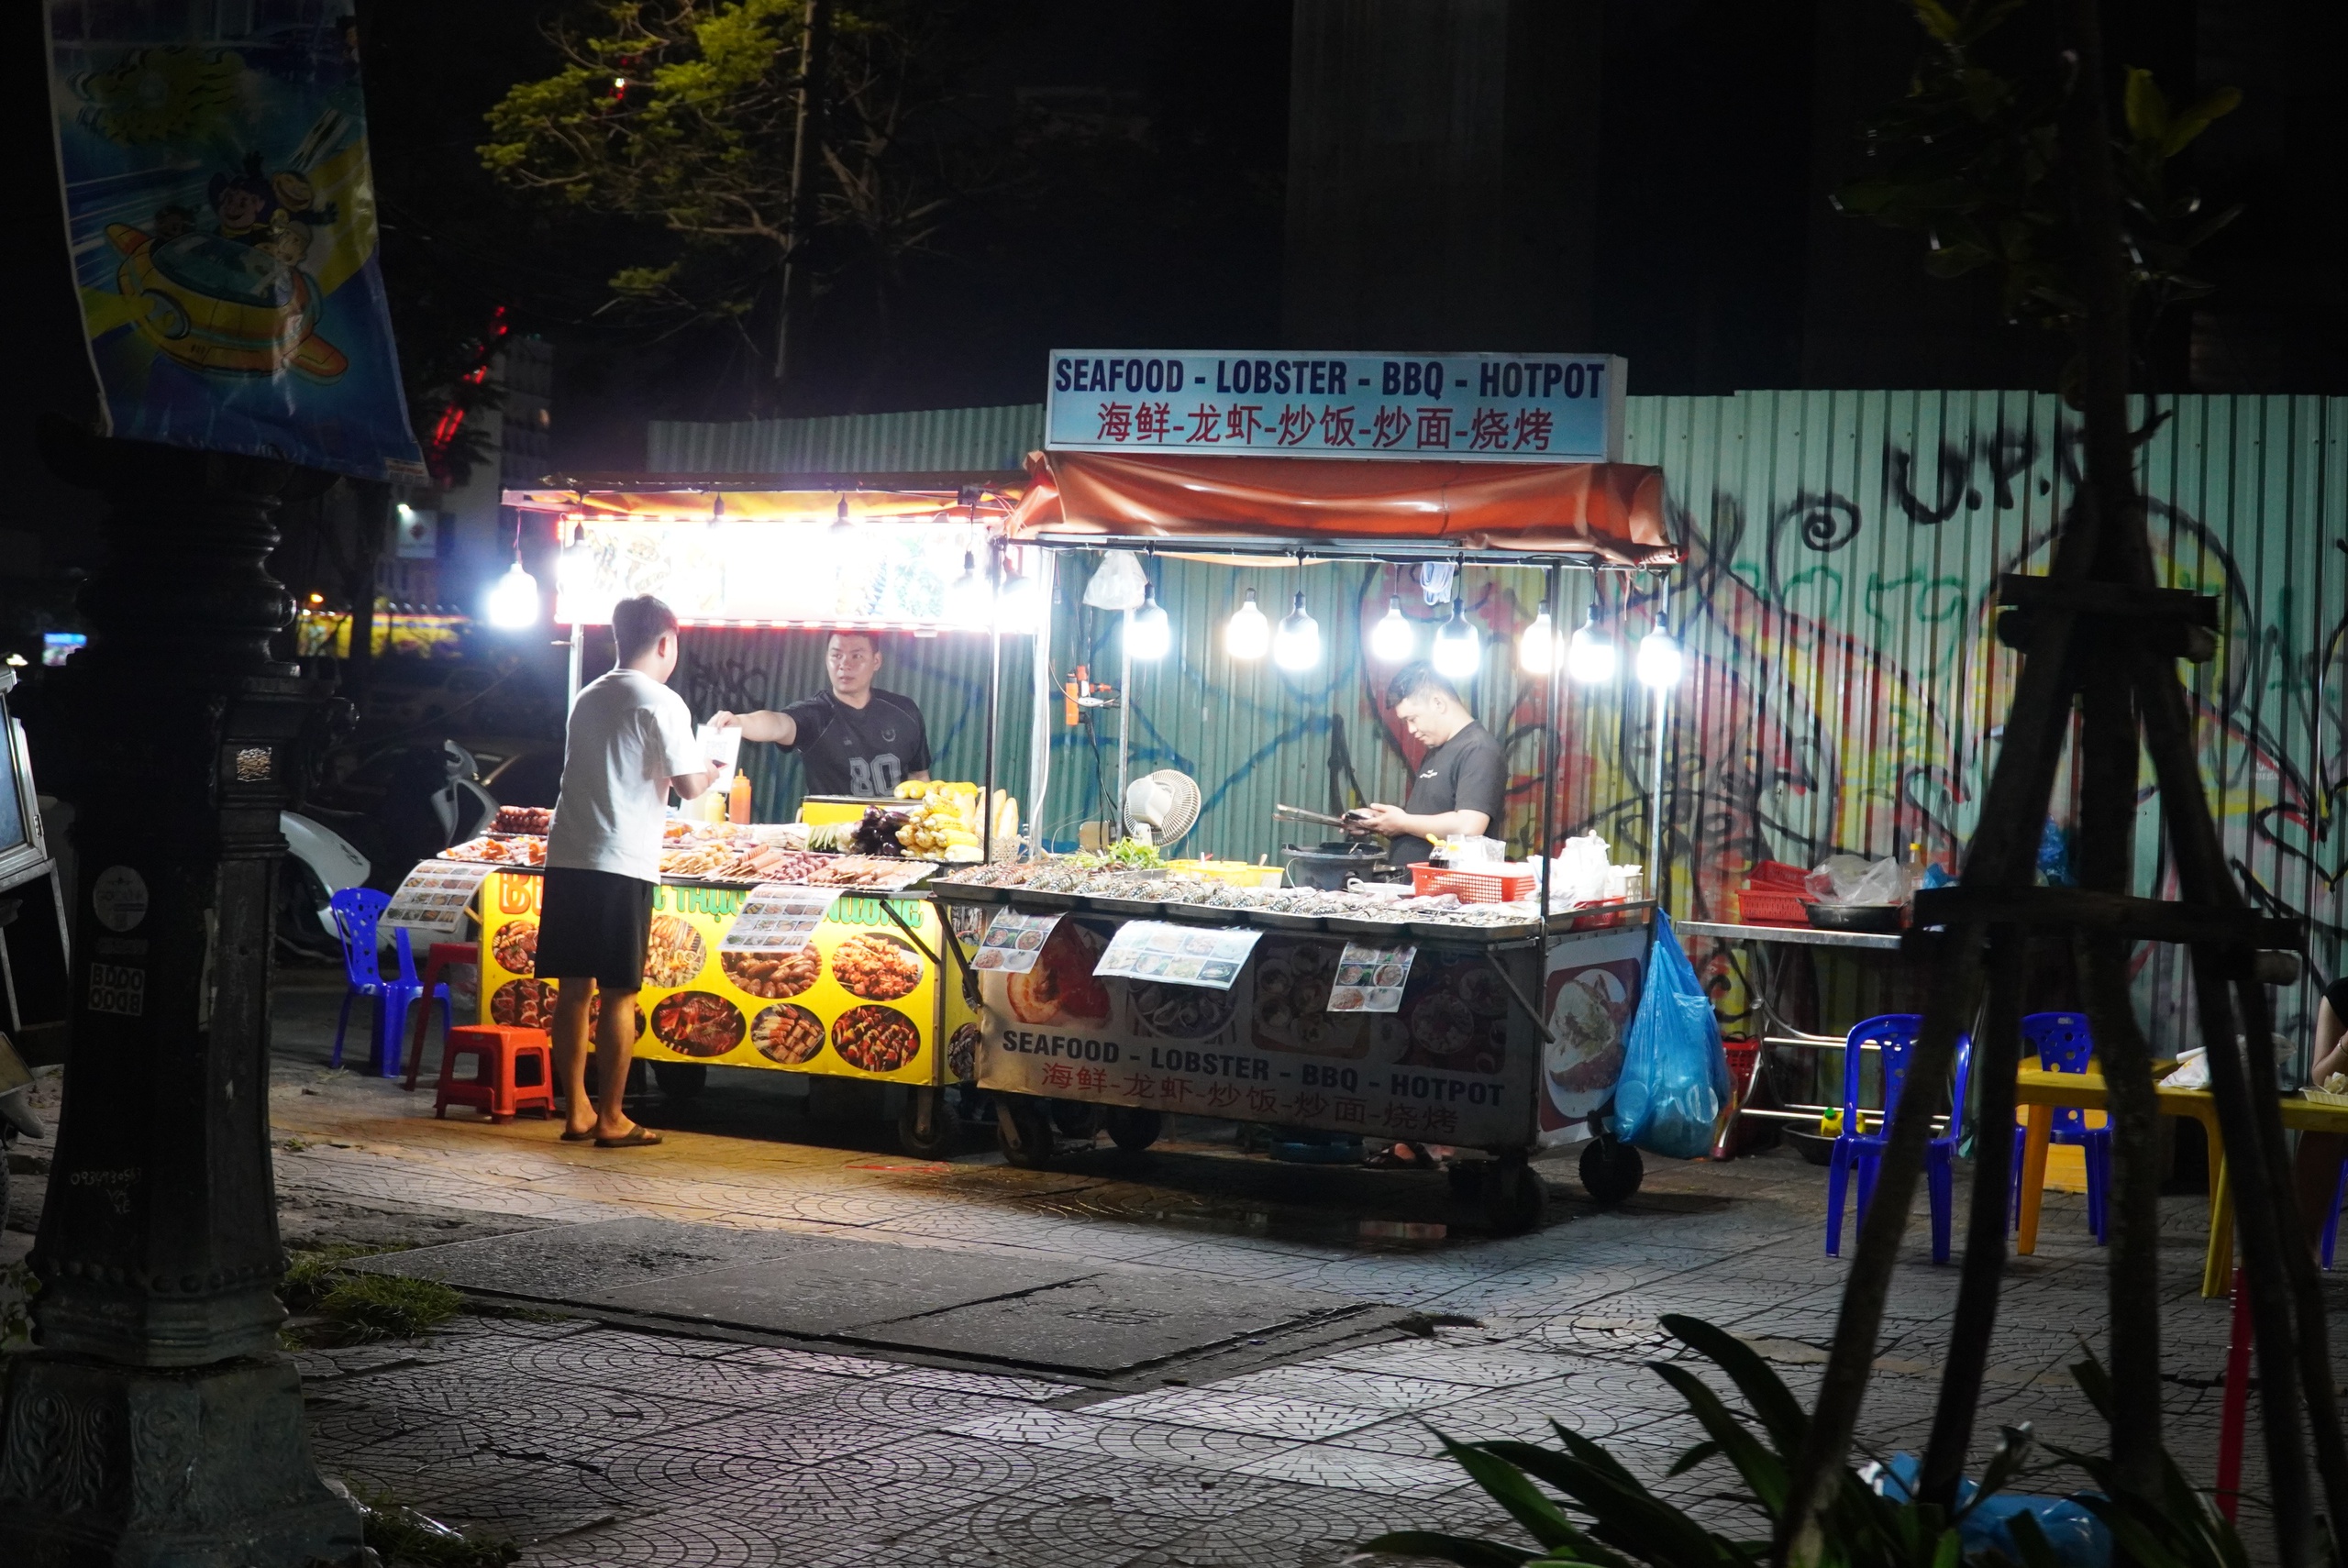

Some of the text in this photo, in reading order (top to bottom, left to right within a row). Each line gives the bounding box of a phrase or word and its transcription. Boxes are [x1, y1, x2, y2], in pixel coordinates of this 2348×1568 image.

[1055, 359, 1184, 393] SEAFOOD
[1216, 359, 1347, 395] LOBSTER
[1382, 361, 1444, 401] BBQ
[1479, 362, 1604, 399] HOTPOT
[847, 753, 902, 796] 80
[1002, 1029, 1120, 1064] SEAFOOD
[1150, 1046, 1270, 1081] LOBSTER
[1301, 1064, 1358, 1093] BBQ
[1390, 1073, 1505, 1107] HOTPOT
